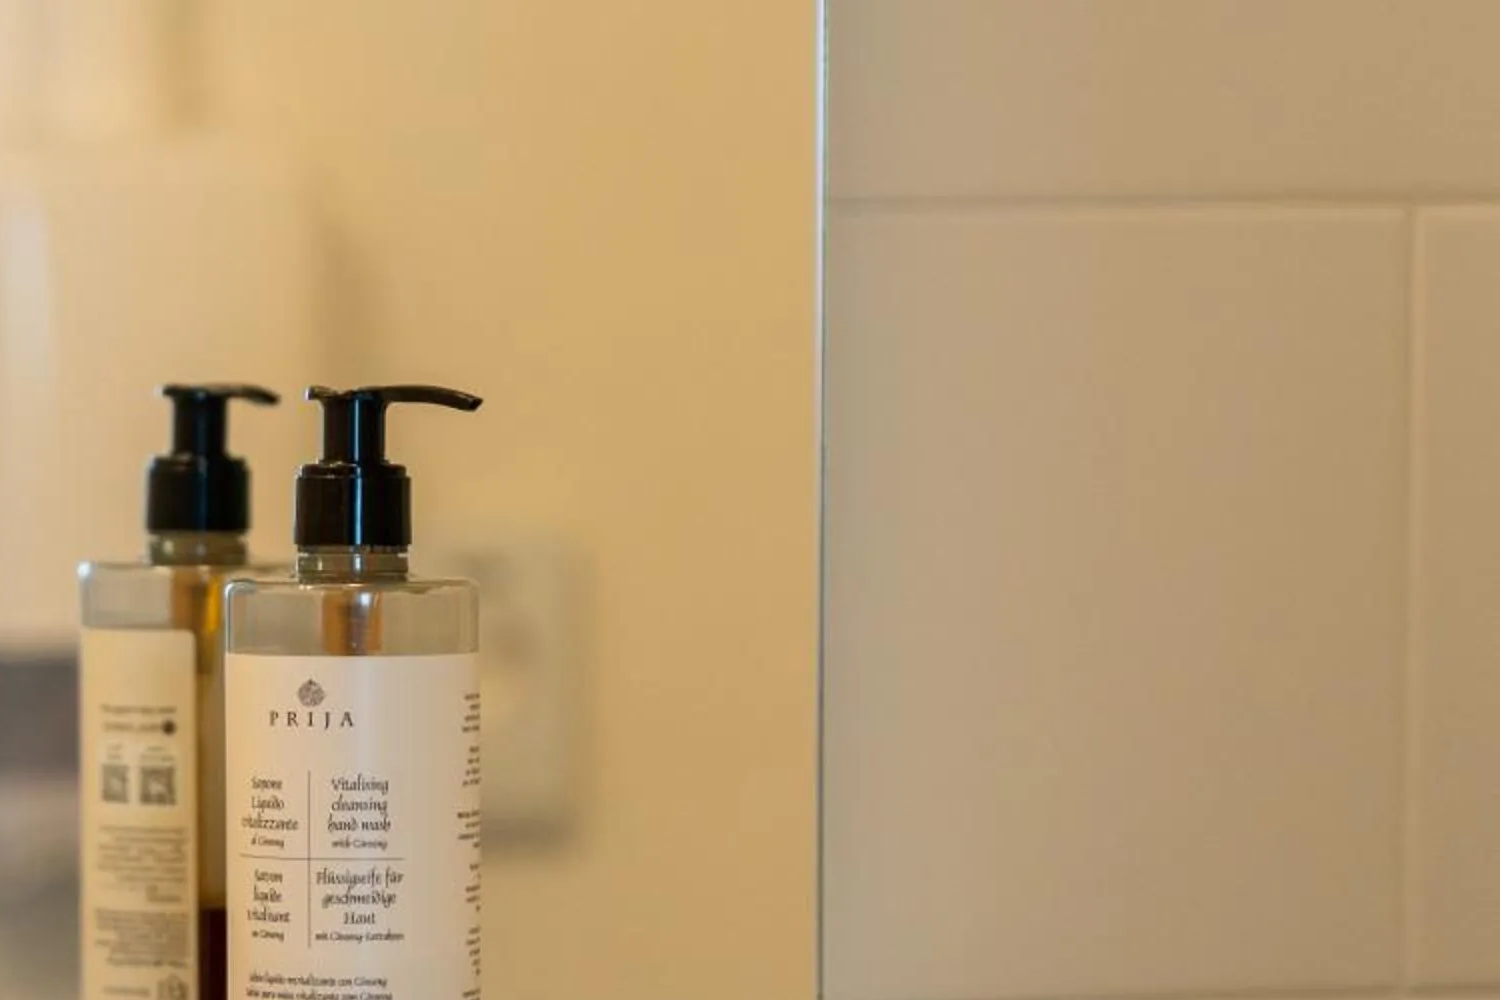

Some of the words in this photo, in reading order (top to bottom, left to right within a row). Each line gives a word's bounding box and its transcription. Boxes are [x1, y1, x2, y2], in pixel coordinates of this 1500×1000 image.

[269, 711, 354, 729] PRIJA
[331, 793, 388, 817] cleansing
[328, 813, 358, 832] hand
[361, 817, 391, 832] wash
[343, 912, 375, 925] Haut
